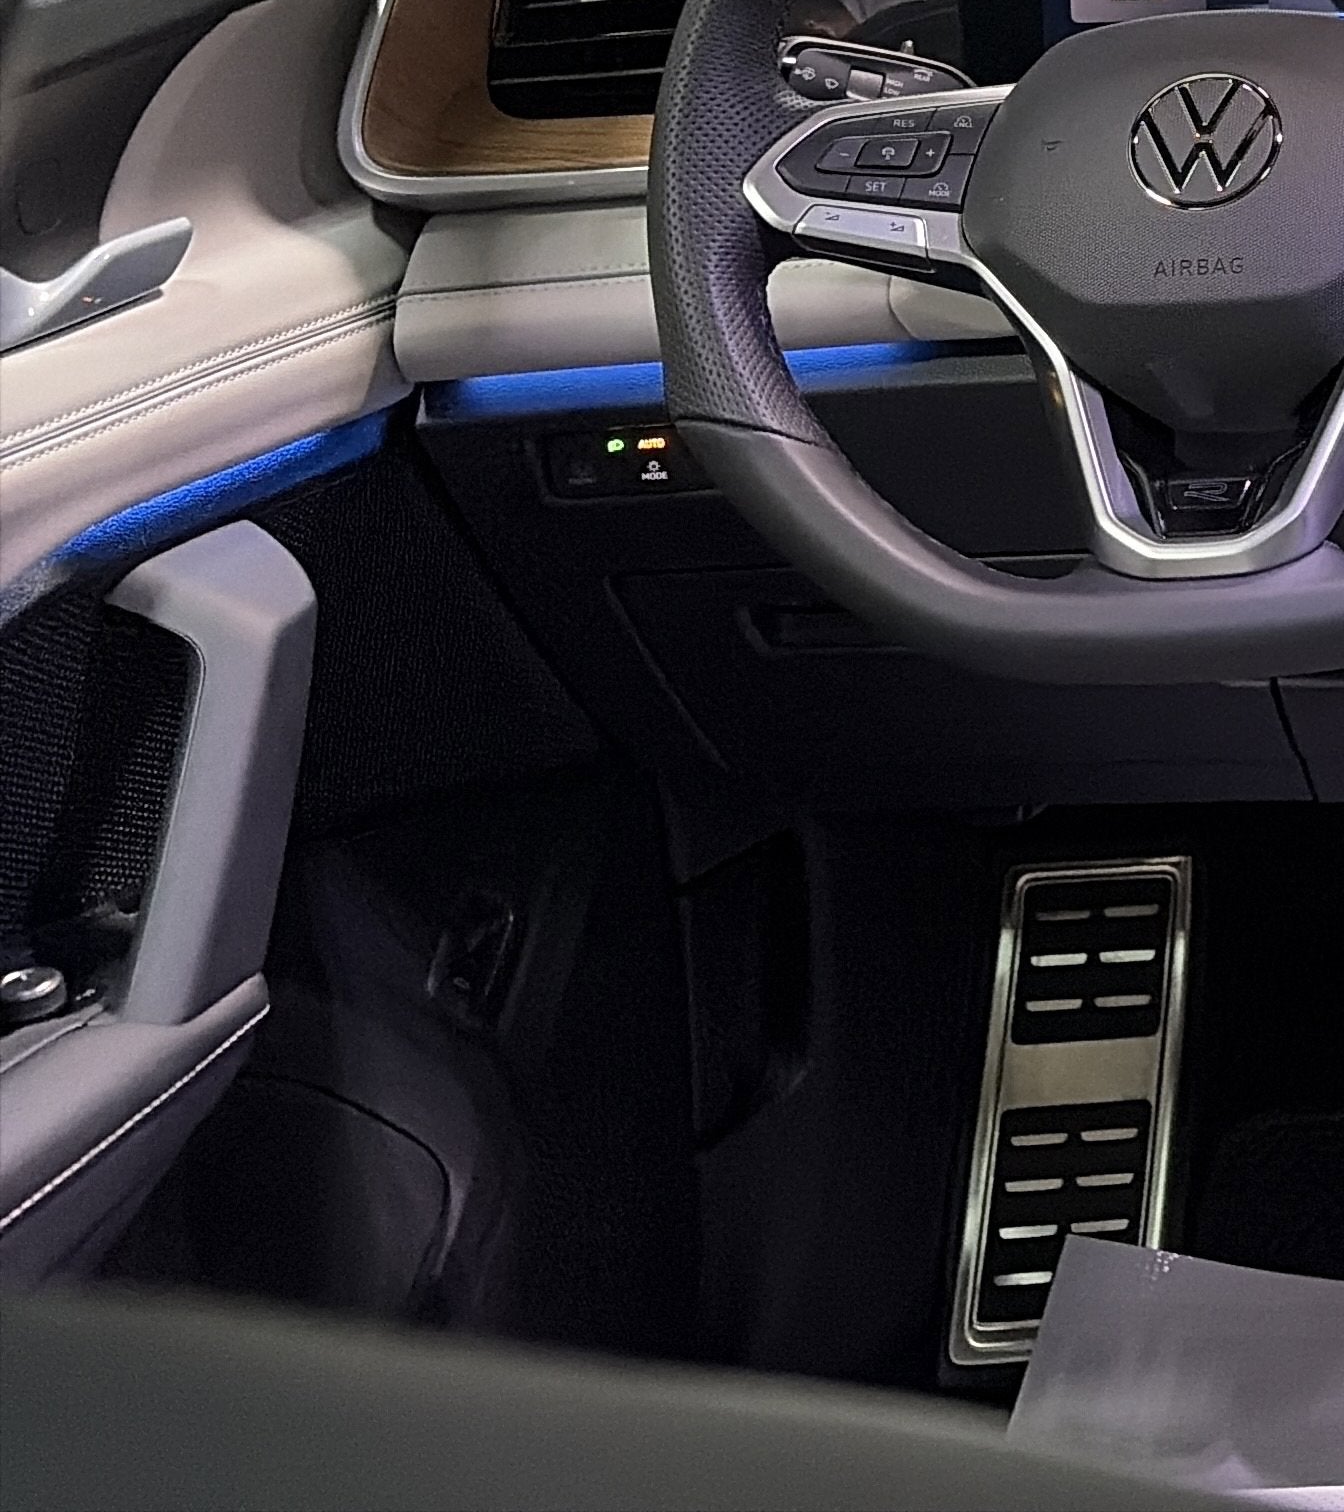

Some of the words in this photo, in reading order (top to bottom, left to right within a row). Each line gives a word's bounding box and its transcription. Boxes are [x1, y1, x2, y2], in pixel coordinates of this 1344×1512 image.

[893, 119, 915, 129] RES
[865, 181, 887, 192] SET
[1153, 257, 1244, 278] AIRBAG
[641, 470, 668, 480] MODE
